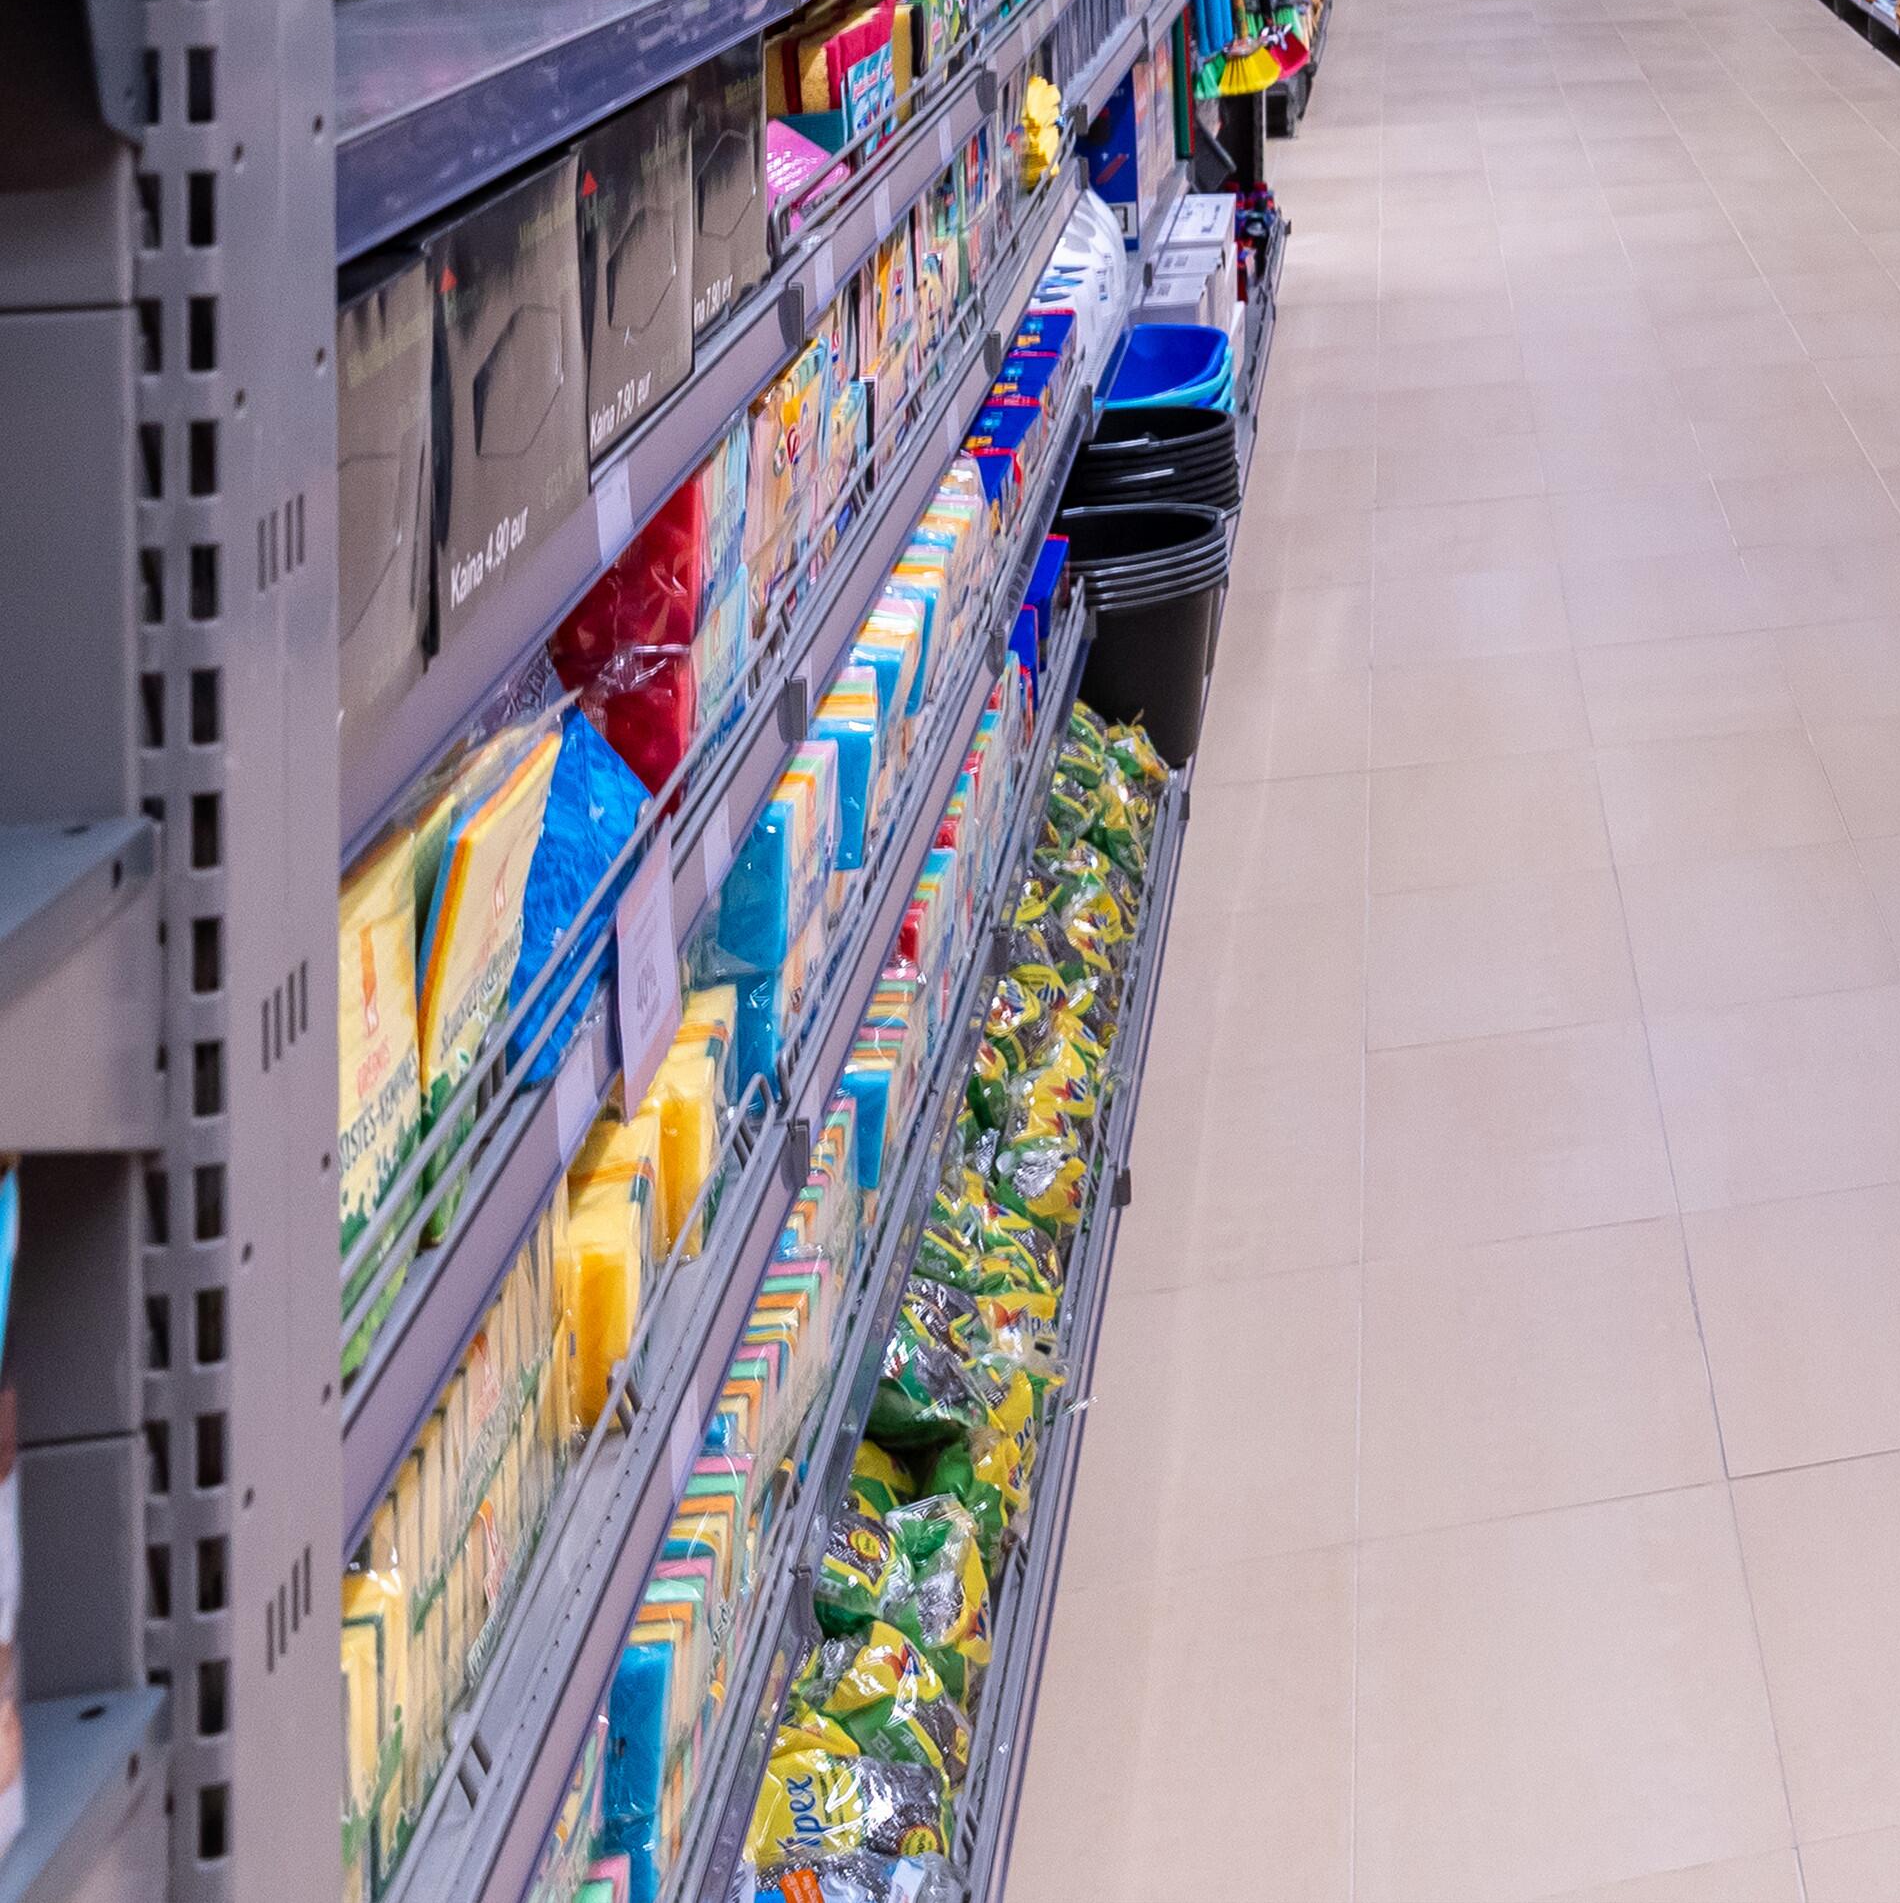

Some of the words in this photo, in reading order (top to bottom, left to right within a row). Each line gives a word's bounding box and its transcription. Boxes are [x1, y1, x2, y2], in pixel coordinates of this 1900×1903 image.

[590, 404, 615, 448] Kaina
[615, 381, 636, 426] 7.90
[637, 370, 652, 399] eur
[450, 555, 484, 612] Kaina
[484, 517, 509, 574] 4.90
[509, 506, 528, 550] eur
